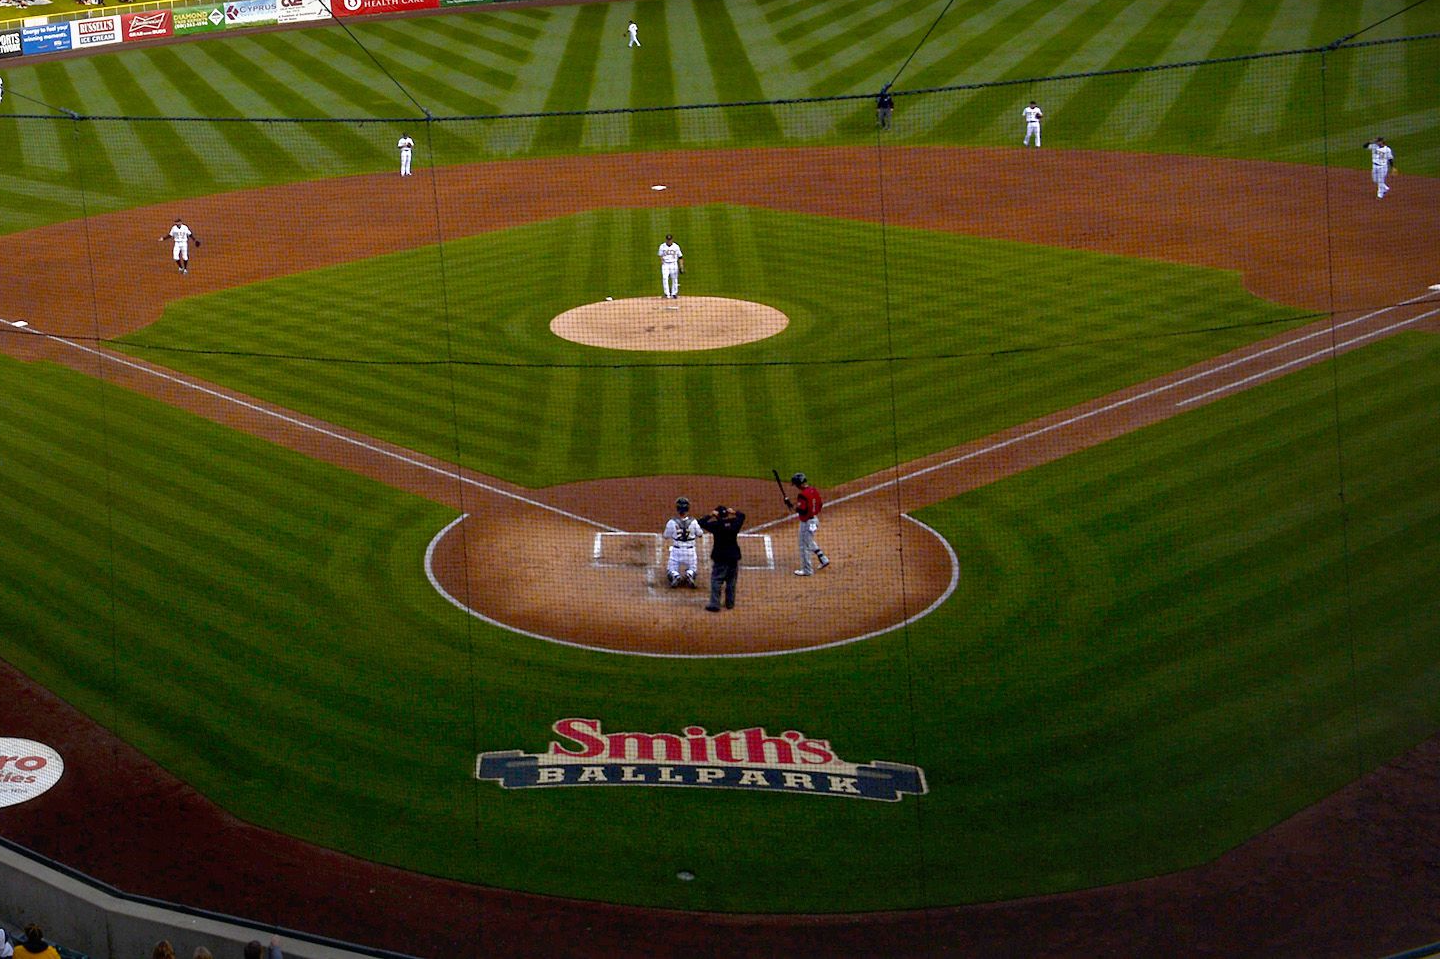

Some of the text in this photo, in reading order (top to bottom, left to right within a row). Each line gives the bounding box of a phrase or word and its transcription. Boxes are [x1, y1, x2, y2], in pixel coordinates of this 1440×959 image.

[240, 4, 277, 13] CYPRUS
[173, 12, 208, 21] DIAMOND
[57, 25, 68, 33] your
[79, 20, 113, 33] RUSSELL'S
[93, 34, 115, 42] CREAM
[552, 719, 835, 765] Smith's
[537, 766, 862, 794] BALLPARK
